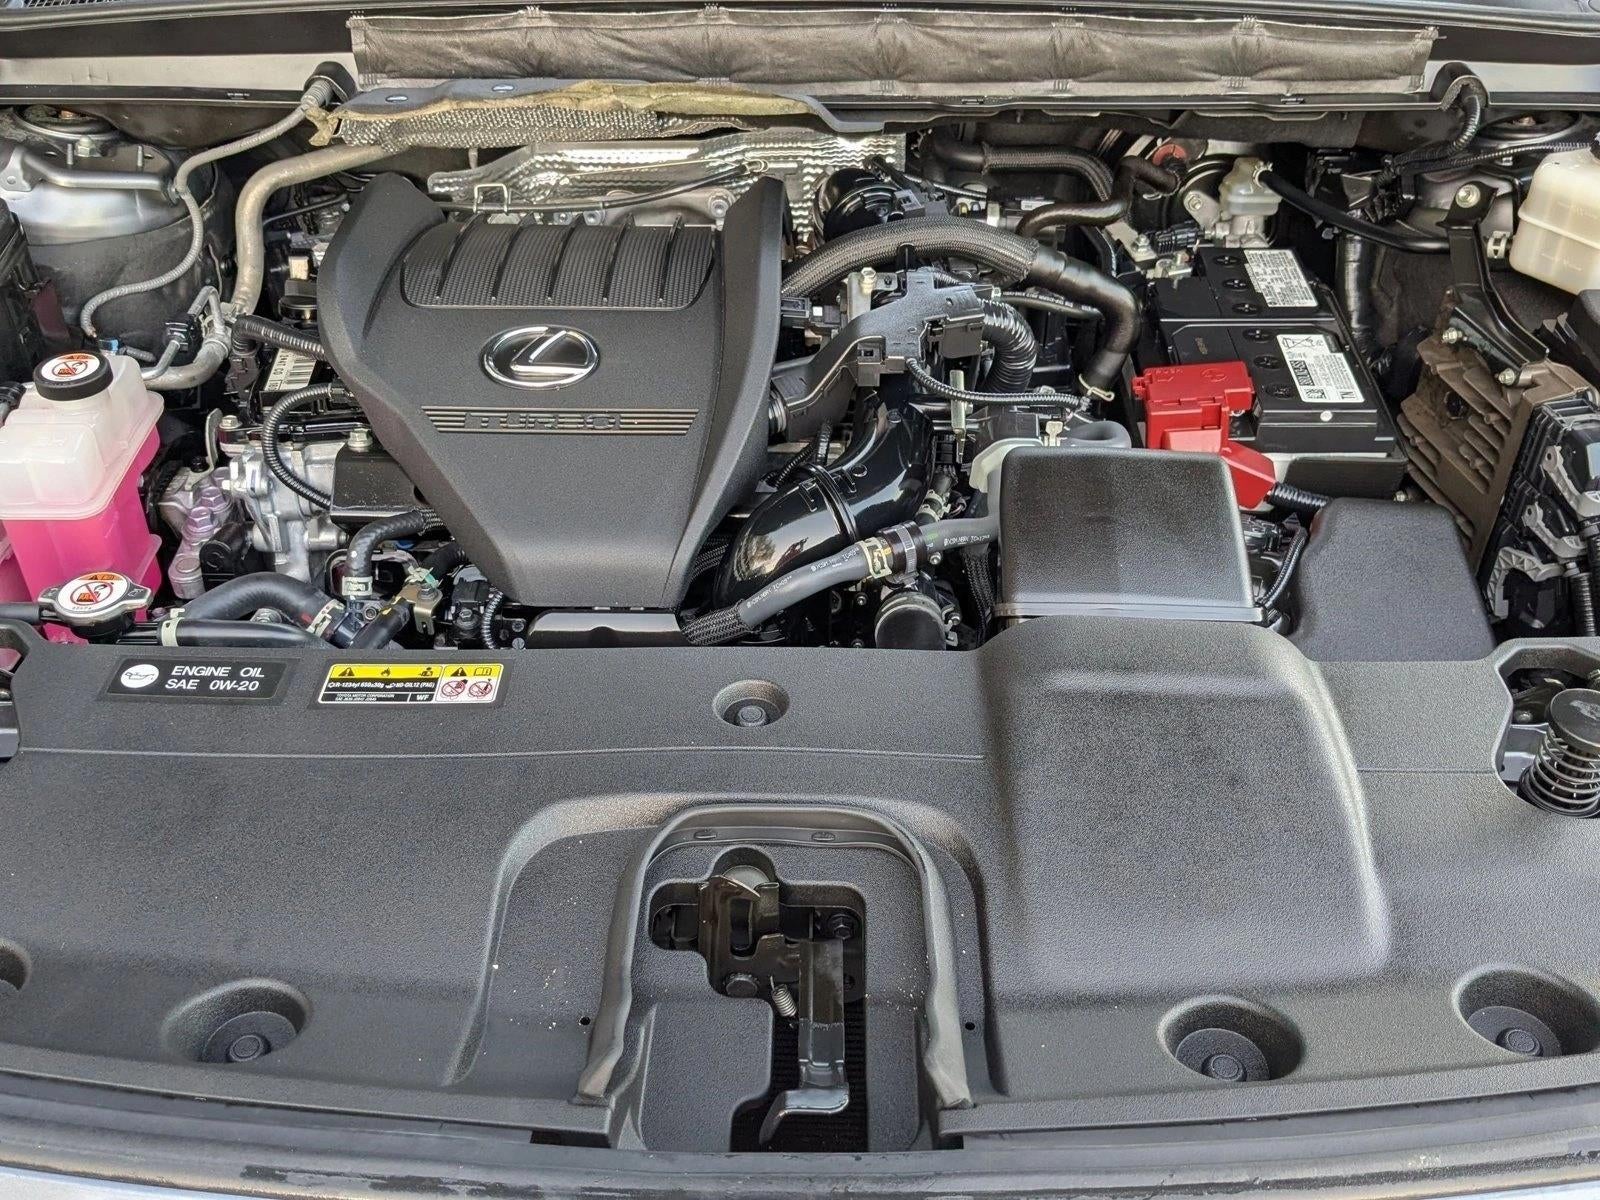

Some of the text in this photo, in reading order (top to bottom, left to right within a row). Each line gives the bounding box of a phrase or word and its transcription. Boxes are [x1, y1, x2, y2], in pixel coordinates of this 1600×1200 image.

[470, 412, 616, 430] TURBO
[171, 665, 265, 678] ENGINE OIL
[165, 679, 259, 691] SAE 0W-20
